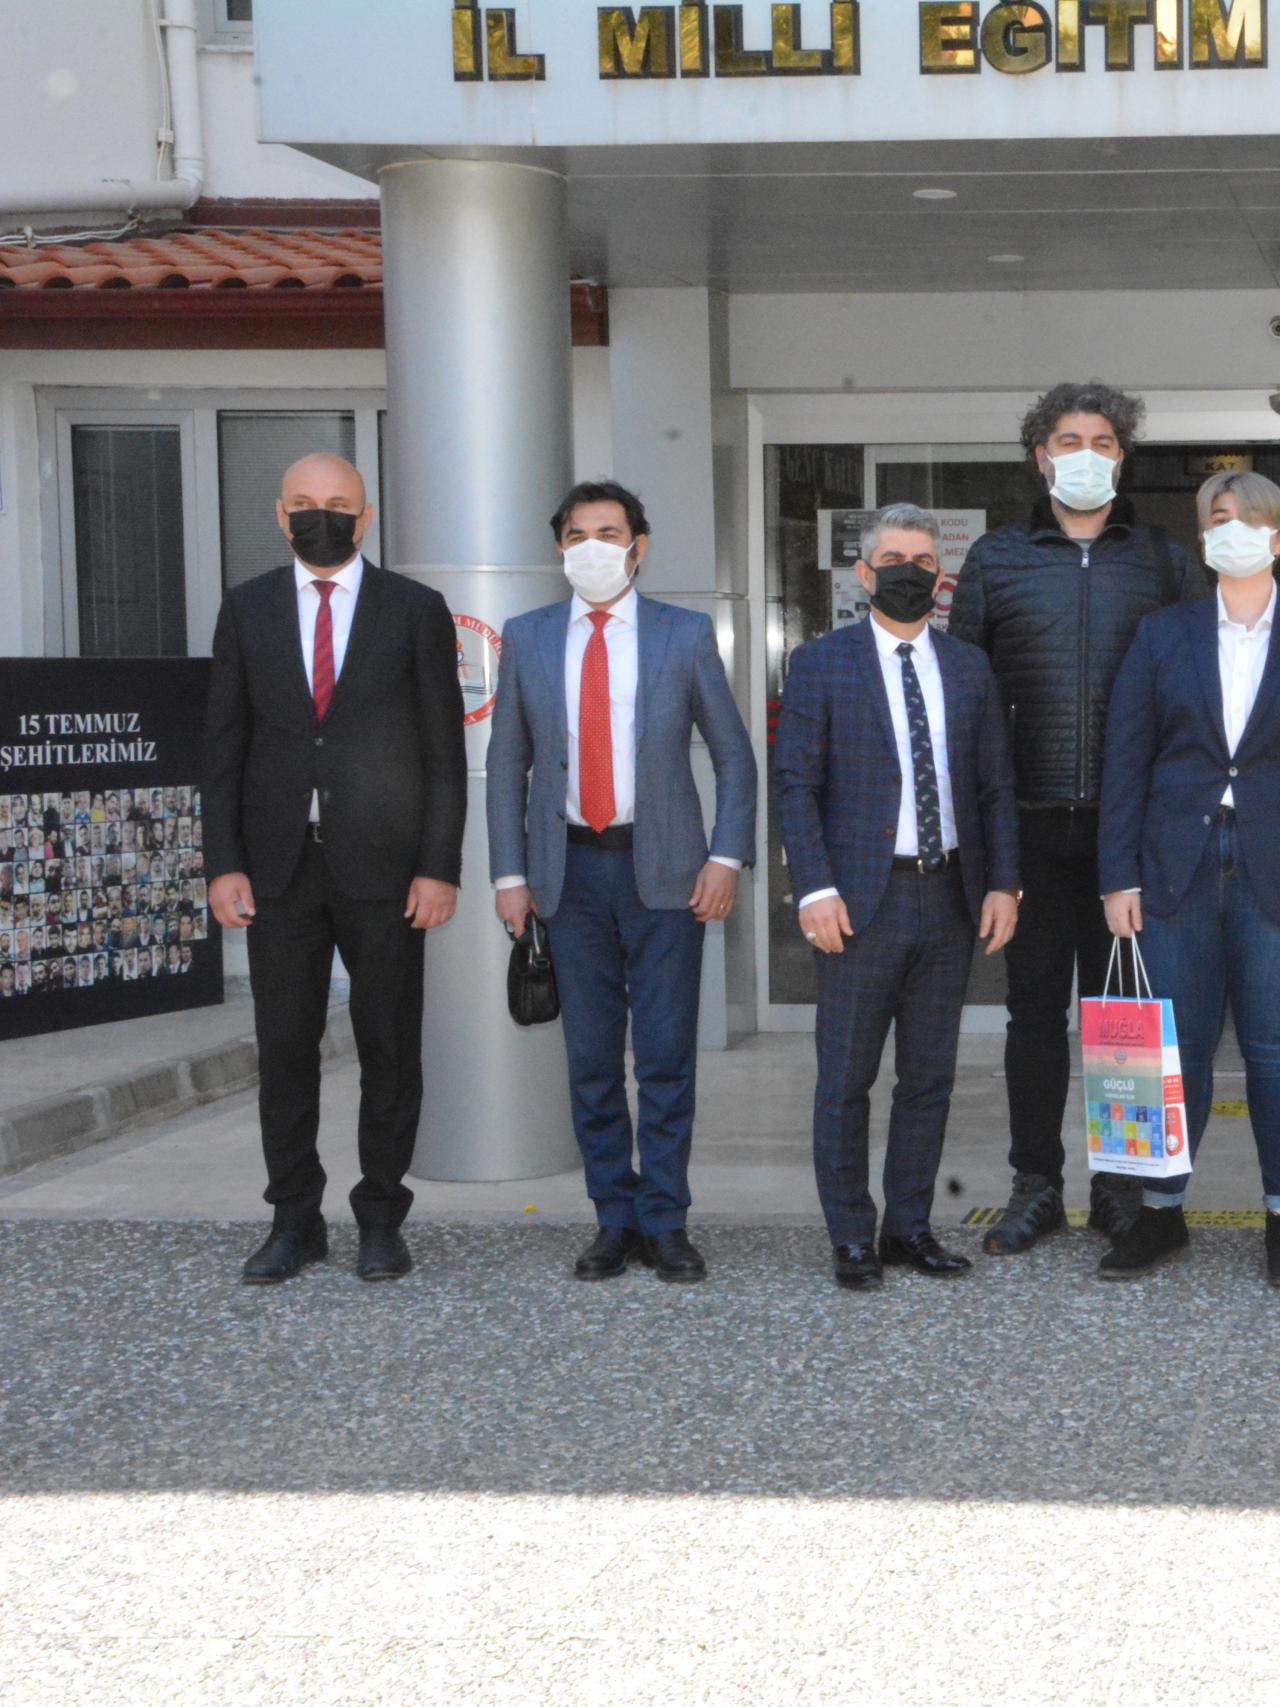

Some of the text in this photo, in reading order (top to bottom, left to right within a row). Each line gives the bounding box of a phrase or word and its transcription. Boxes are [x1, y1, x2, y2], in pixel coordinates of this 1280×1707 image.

[942, 532, 969, 541] ADAN
[18, 712, 142, 736] 15 TEMMUZ
